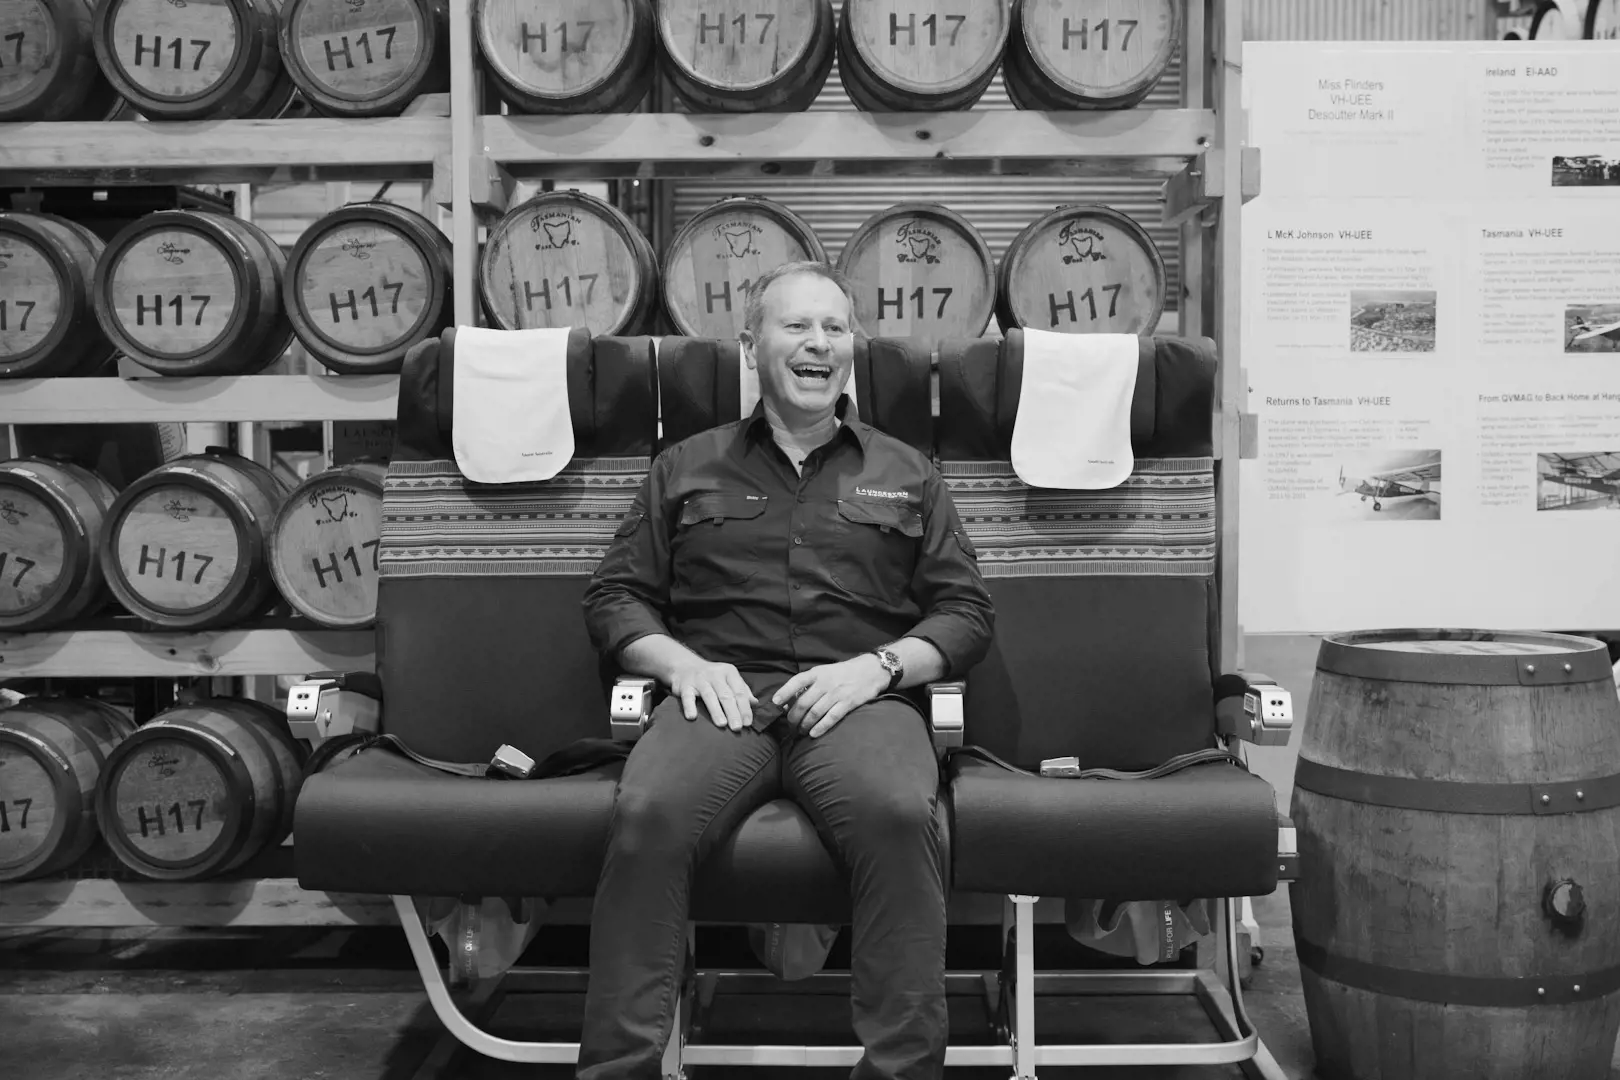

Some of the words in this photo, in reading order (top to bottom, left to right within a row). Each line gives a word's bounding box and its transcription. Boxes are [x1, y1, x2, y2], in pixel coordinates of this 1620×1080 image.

[521, 21, 596, 53] H17
[700, 13, 775, 44] H17
[889, 13, 966, 46] H17
[1062, 18, 1138, 51] H17
[134, 34, 211, 71] H17
[324, 27, 397, 71] H17
[1318, 79, 1341, 91] Miss
[1344, 78, 1384, 91] Flinders
[1526, 66, 1558, 77] EI-AAD
[1308, 108, 1357, 121] Desoutter
[1360, 108, 1384, 121] Mark
[1330, 94, 1373, 106] VH-UEE
[1296, 229, 1334, 240] Johnson
[1338, 229, 1373, 240] VH-UEE
[1481, 228, 1524, 239] Tasmania
[1528, 228, 1564, 239] VH-UEE
[329, 283, 404, 323] H17
[524, 274, 599, 311] H17
[705, 278, 751, 314] H1
[878, 286, 953, 320] H17
[1049, 284, 1122, 328] H17
[137, 295, 211, 326] H17
[1266, 396, 1300, 407] Returns
[1302, 397, 1311, 407] to
[1313, 396, 1354, 407] Tasmania
[1357, 396, 1391, 406] VH-UEE
[1478, 394, 1500, 403] From
[1535, 394, 1544, 402] to
[1545, 393, 1564, 402] Back
[1567, 392, 1590, 402] Home
[138, 544, 213, 585] H17
[312, 539, 380, 588] H17
[137, 799, 206, 838] H17
[1164, 909, 1173, 926] LIFE
[1165, 927, 1174, 943] FOR
